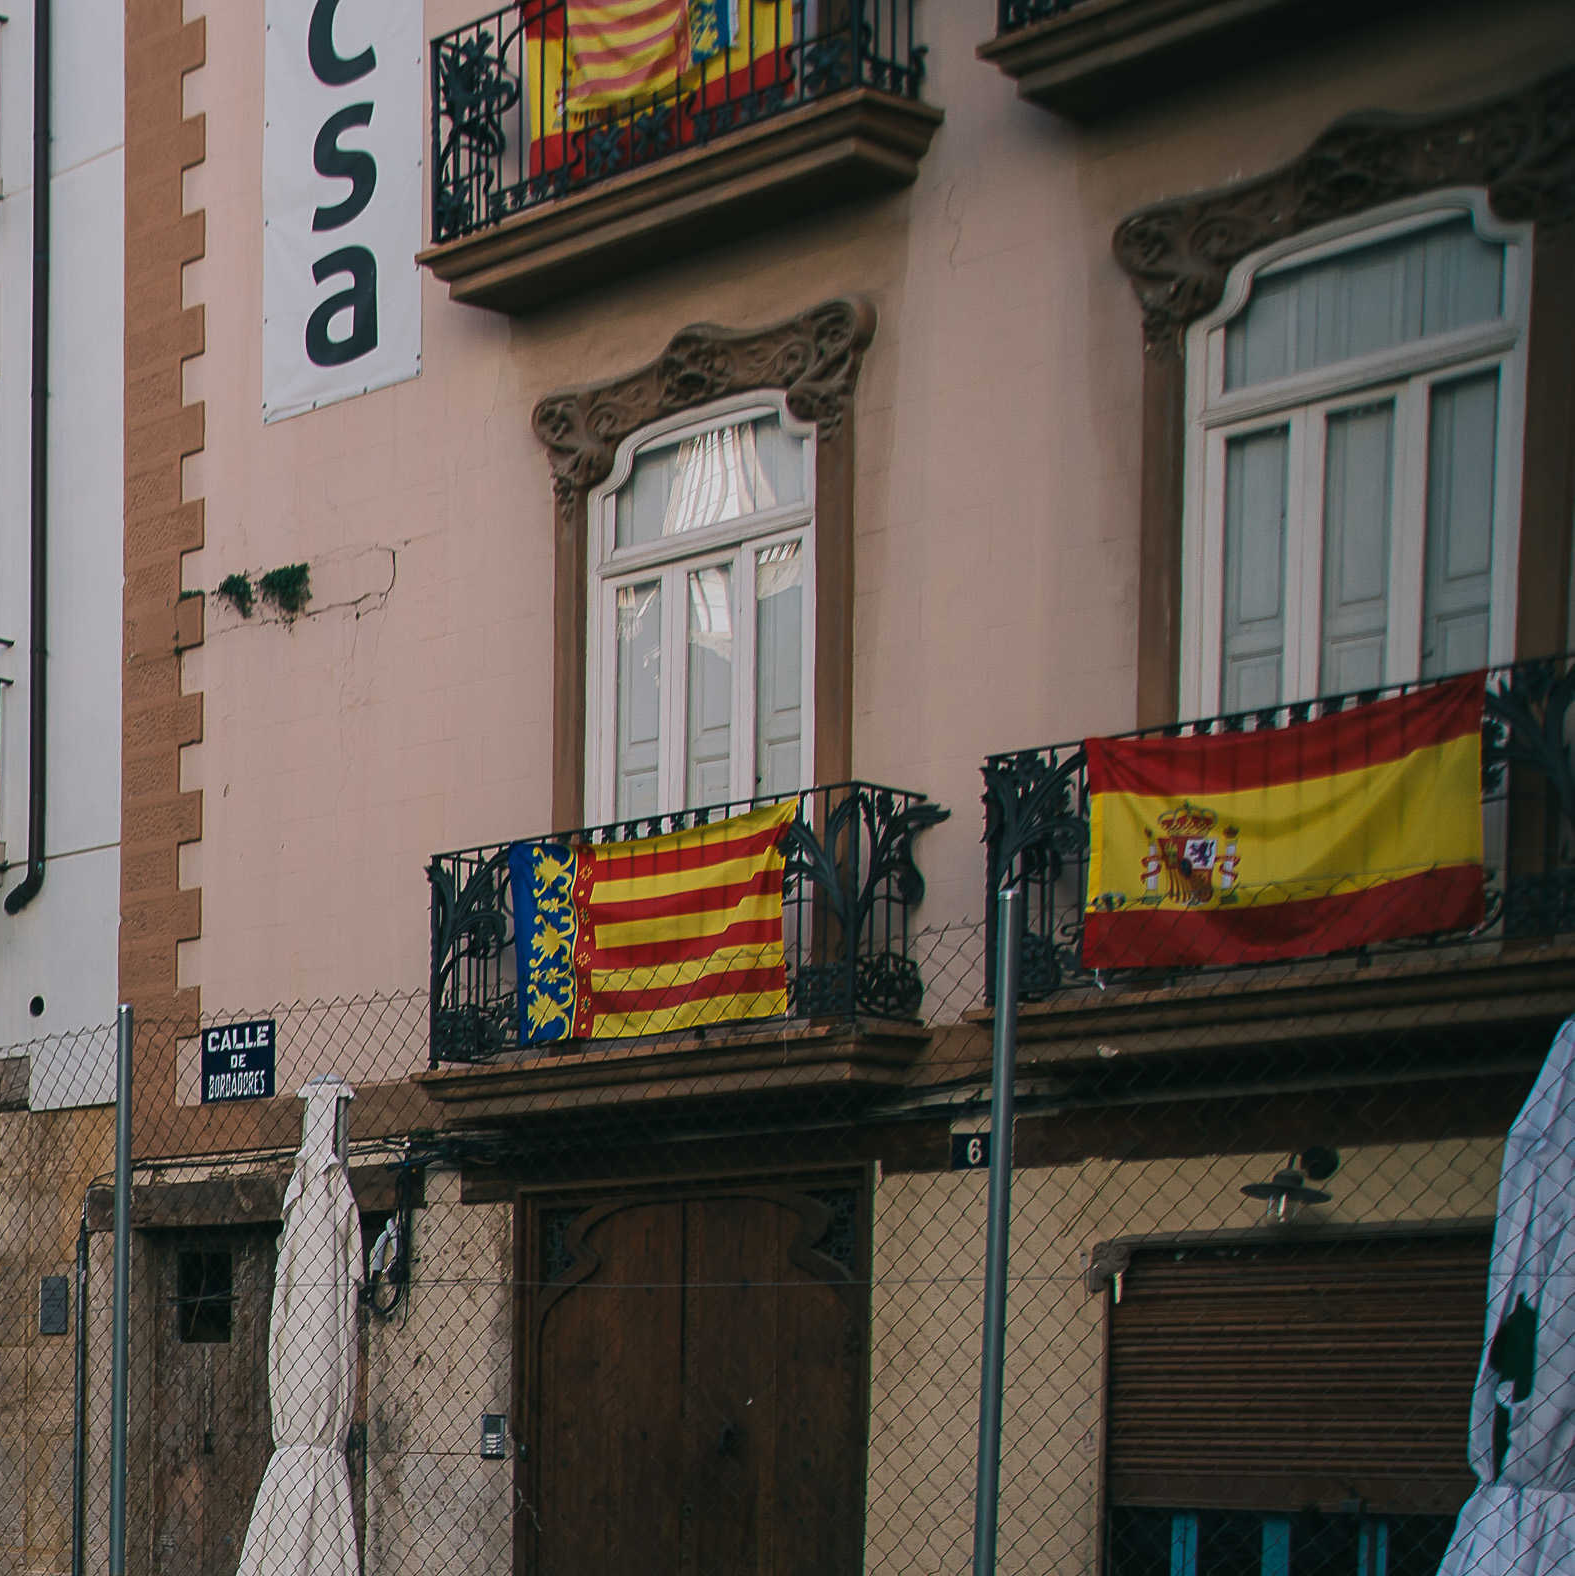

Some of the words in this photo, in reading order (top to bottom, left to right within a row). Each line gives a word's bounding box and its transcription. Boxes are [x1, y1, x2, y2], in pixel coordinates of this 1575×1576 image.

[207, 1024, 270, 1053] CALLE
[230, 1053, 247, 1069] DE
[207, 1069, 266, 1101] BORDADORES
[967, 1137, 983, 1166] 6
